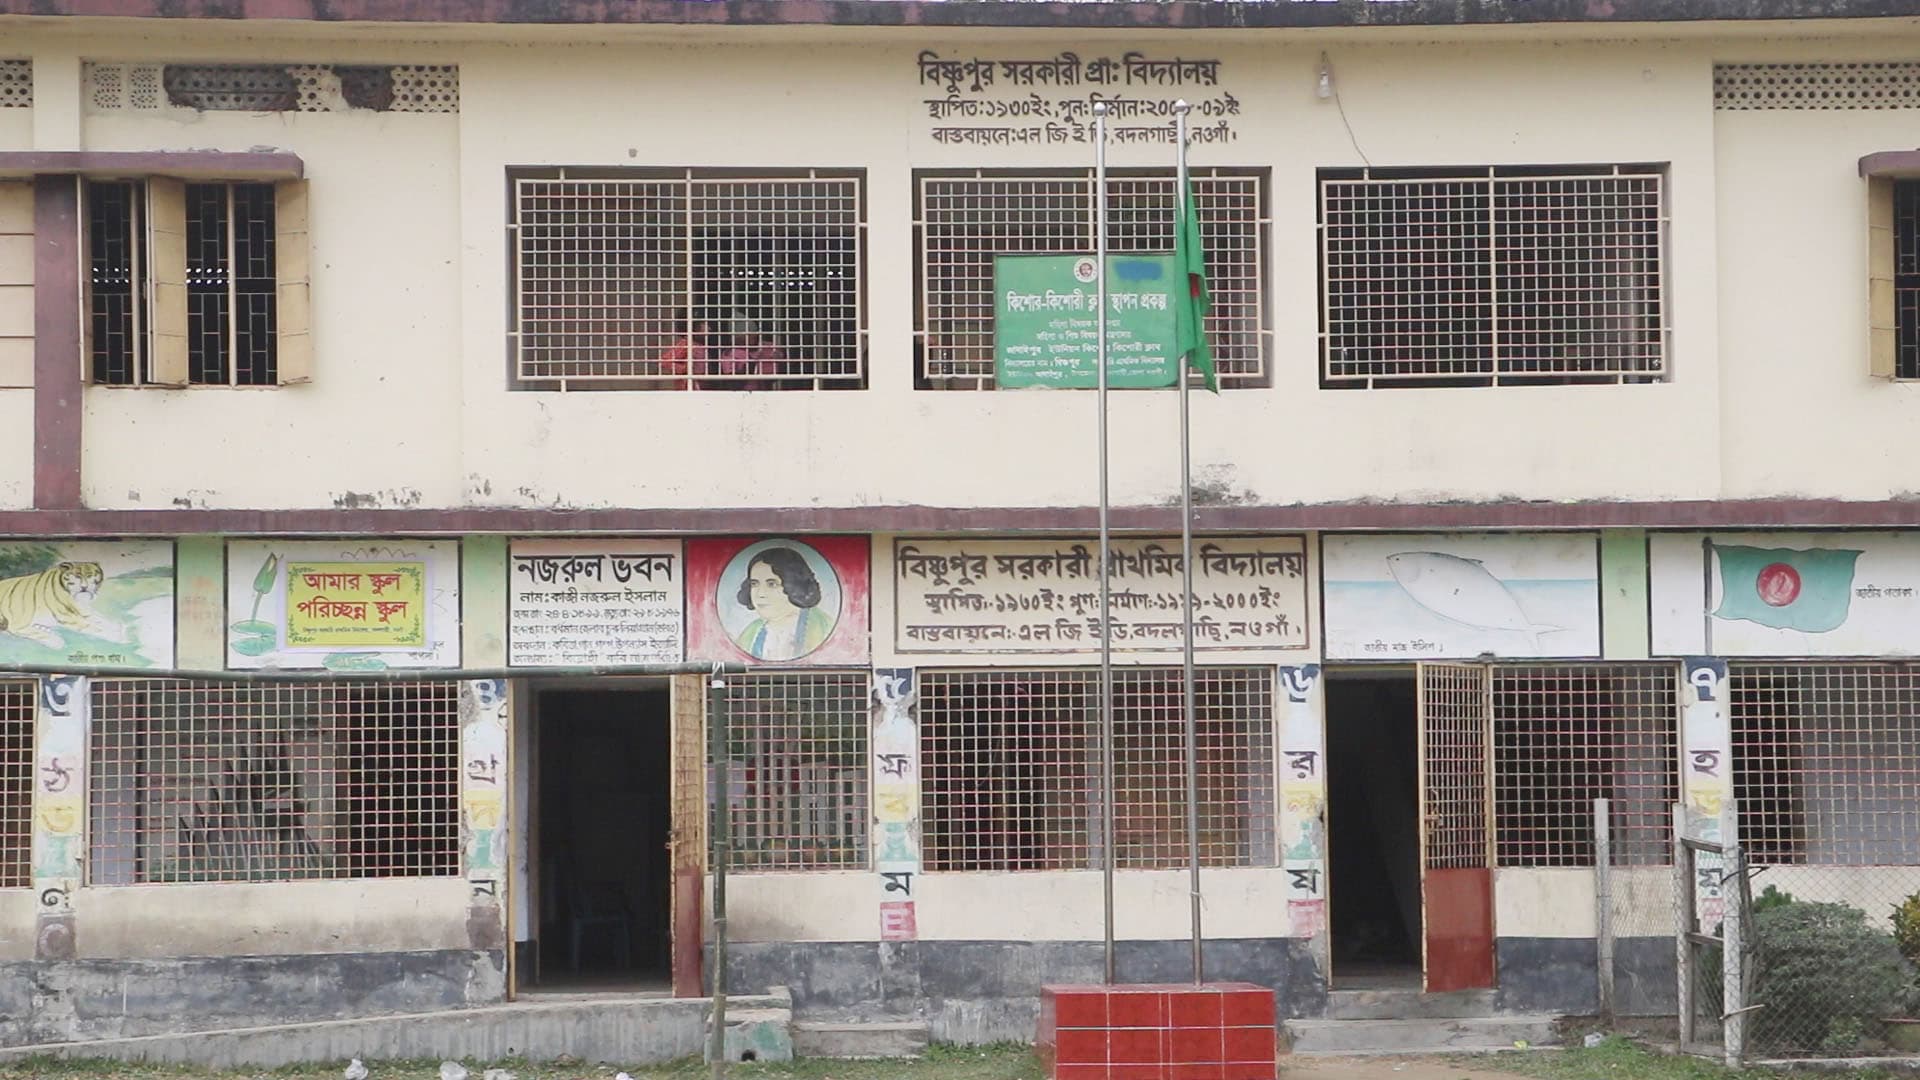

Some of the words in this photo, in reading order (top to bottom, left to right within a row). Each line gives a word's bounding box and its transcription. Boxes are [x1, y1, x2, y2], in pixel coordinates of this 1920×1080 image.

[918, 51, 995, 93] বিষ্ণুপুর
[999, 52, 1081, 85] সরকারী
[1123, 52, 1221, 86] বিদ্যালয়
[513, 554, 605, 584] নজরুল
[610, 554, 675, 583] ভবন
[899, 545, 988, 587] বিষ্ণুপুর
[994, 544, 1092, 579] সরকারী
[1199, 543, 1305, 579] বিদ্যালয়
[303, 573, 362, 591] আমার
[367, 573, 402, 595] স্কুল
[624, 586, 667, 604] ইসলাম
[297, 595, 368, 621] পরিচ্ছন্ন
[375, 601, 408, 624] স্কুল
[881, 872, 914, 896] ম
